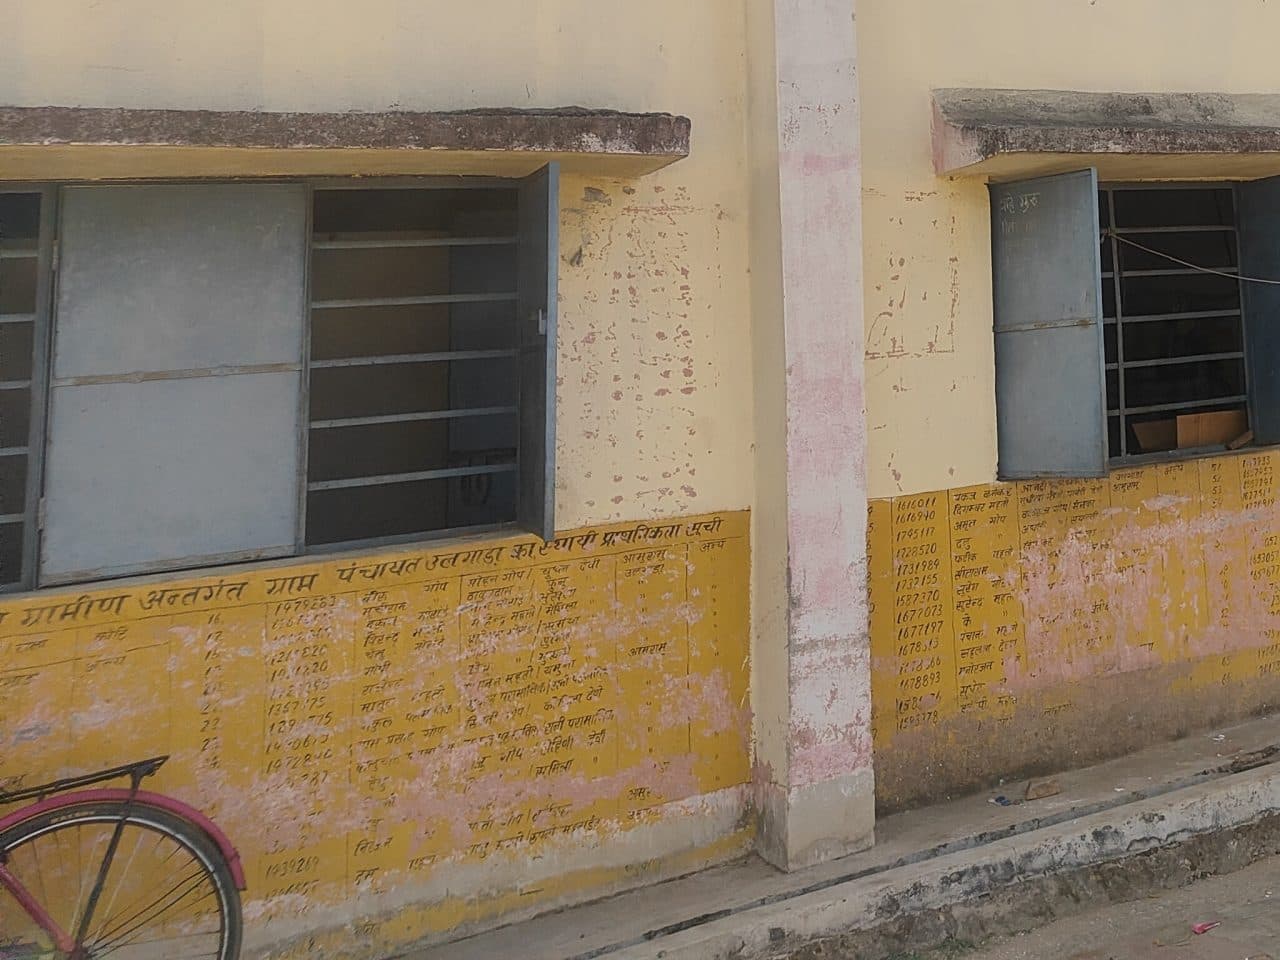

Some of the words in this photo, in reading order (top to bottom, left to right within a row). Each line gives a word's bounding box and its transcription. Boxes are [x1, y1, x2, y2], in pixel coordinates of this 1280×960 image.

[20, 594, 132, 628] ग्रामीण
[264, 572, 321, 596] ग्राम
[336, 556, 424, 583] पंचायत
